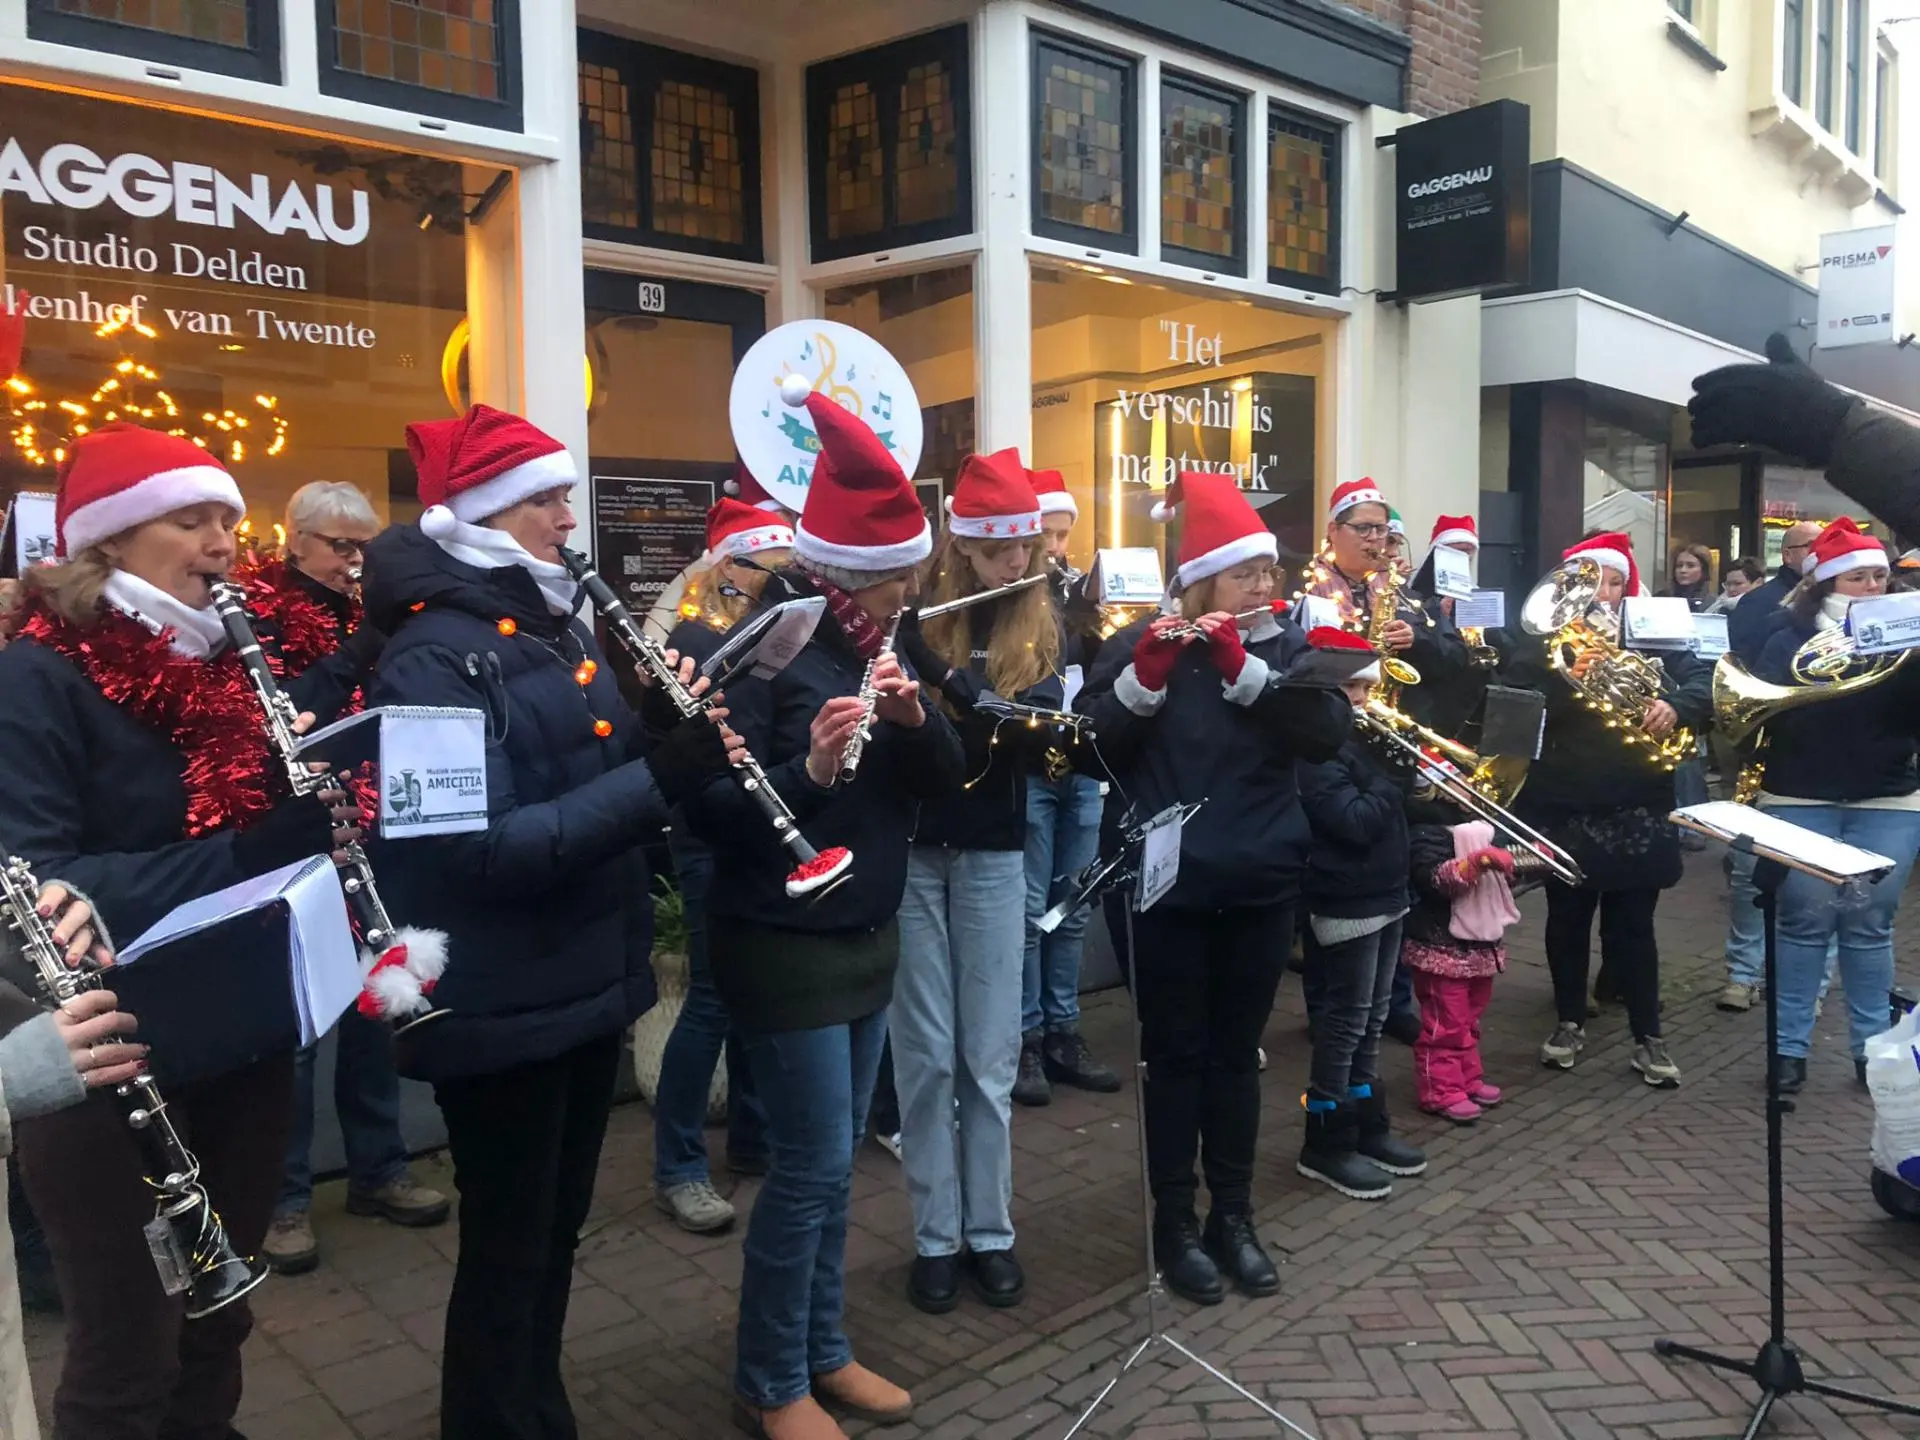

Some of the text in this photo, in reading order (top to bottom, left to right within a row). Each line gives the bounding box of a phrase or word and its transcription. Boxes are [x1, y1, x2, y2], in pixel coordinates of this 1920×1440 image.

[0, 136, 370, 246] AGGENAU
[1408, 165, 1492, 198] GAGGENAU
[23, 225, 307, 290] Studio Delden
[1823, 251, 1876, 267] PRISMA
[641, 285, 662, 309] 39
[164, 307, 233, 336] van
[246, 308, 376, 349] Twente
[1160, 319, 1224, 367] "Het
[1117, 387, 1273, 433] verschil is
[427, 775, 482, 789] AMICITIA
[458, 789, 483, 797] Delden
